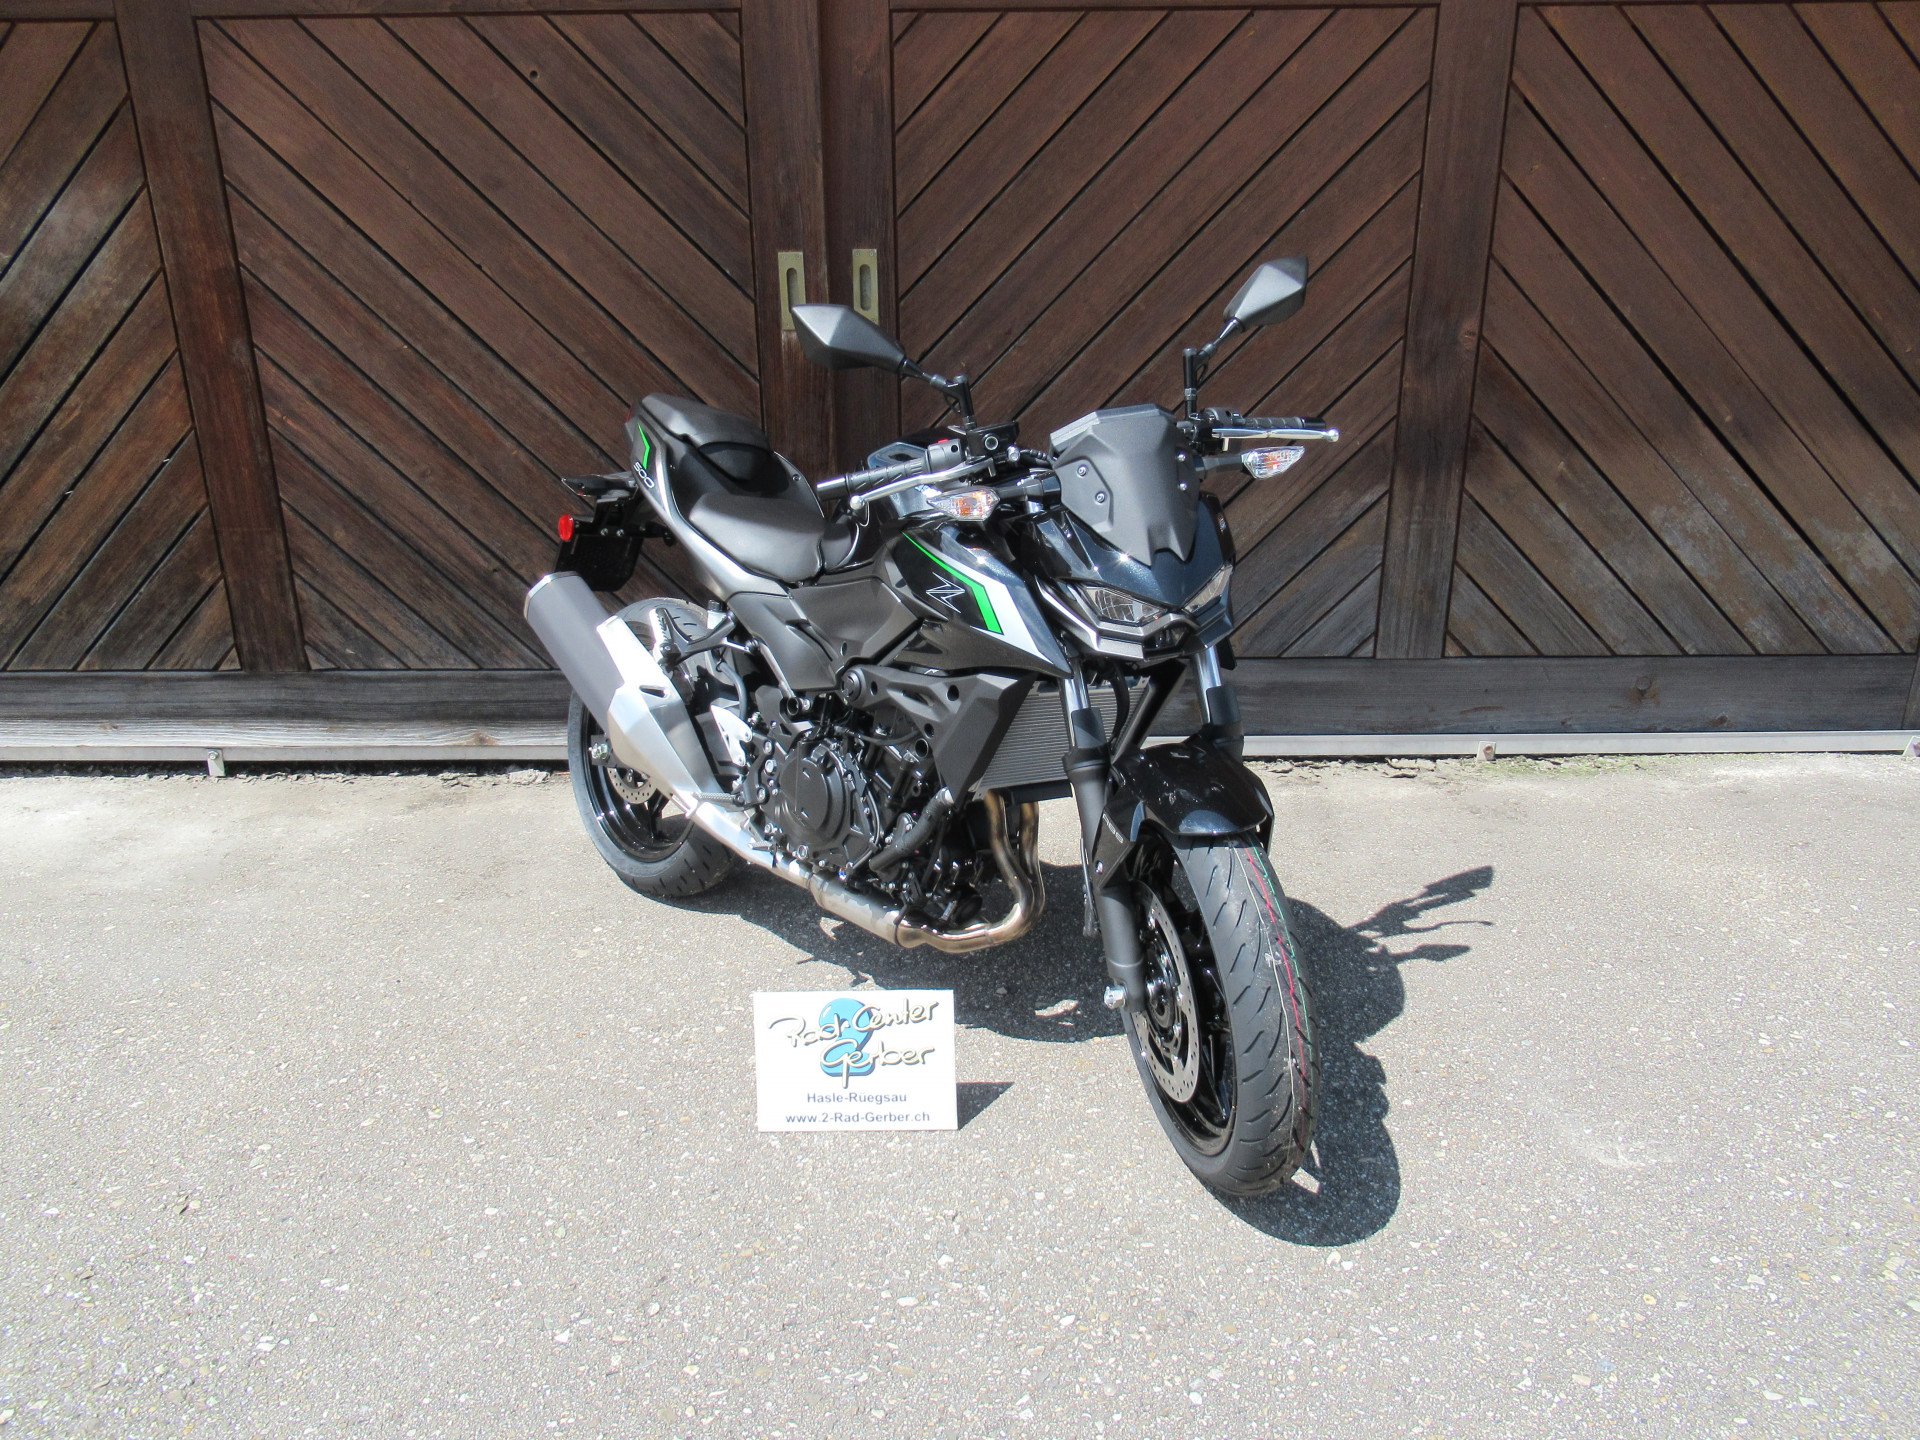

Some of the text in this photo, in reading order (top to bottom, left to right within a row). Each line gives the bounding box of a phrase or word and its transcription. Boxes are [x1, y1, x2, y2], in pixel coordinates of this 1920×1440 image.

[633, 461, 655, 489] 500
[820, 1038, 936, 1090] Gerber
[785, 1111, 931, 1124] www.2-Rad-Gerber.ch
